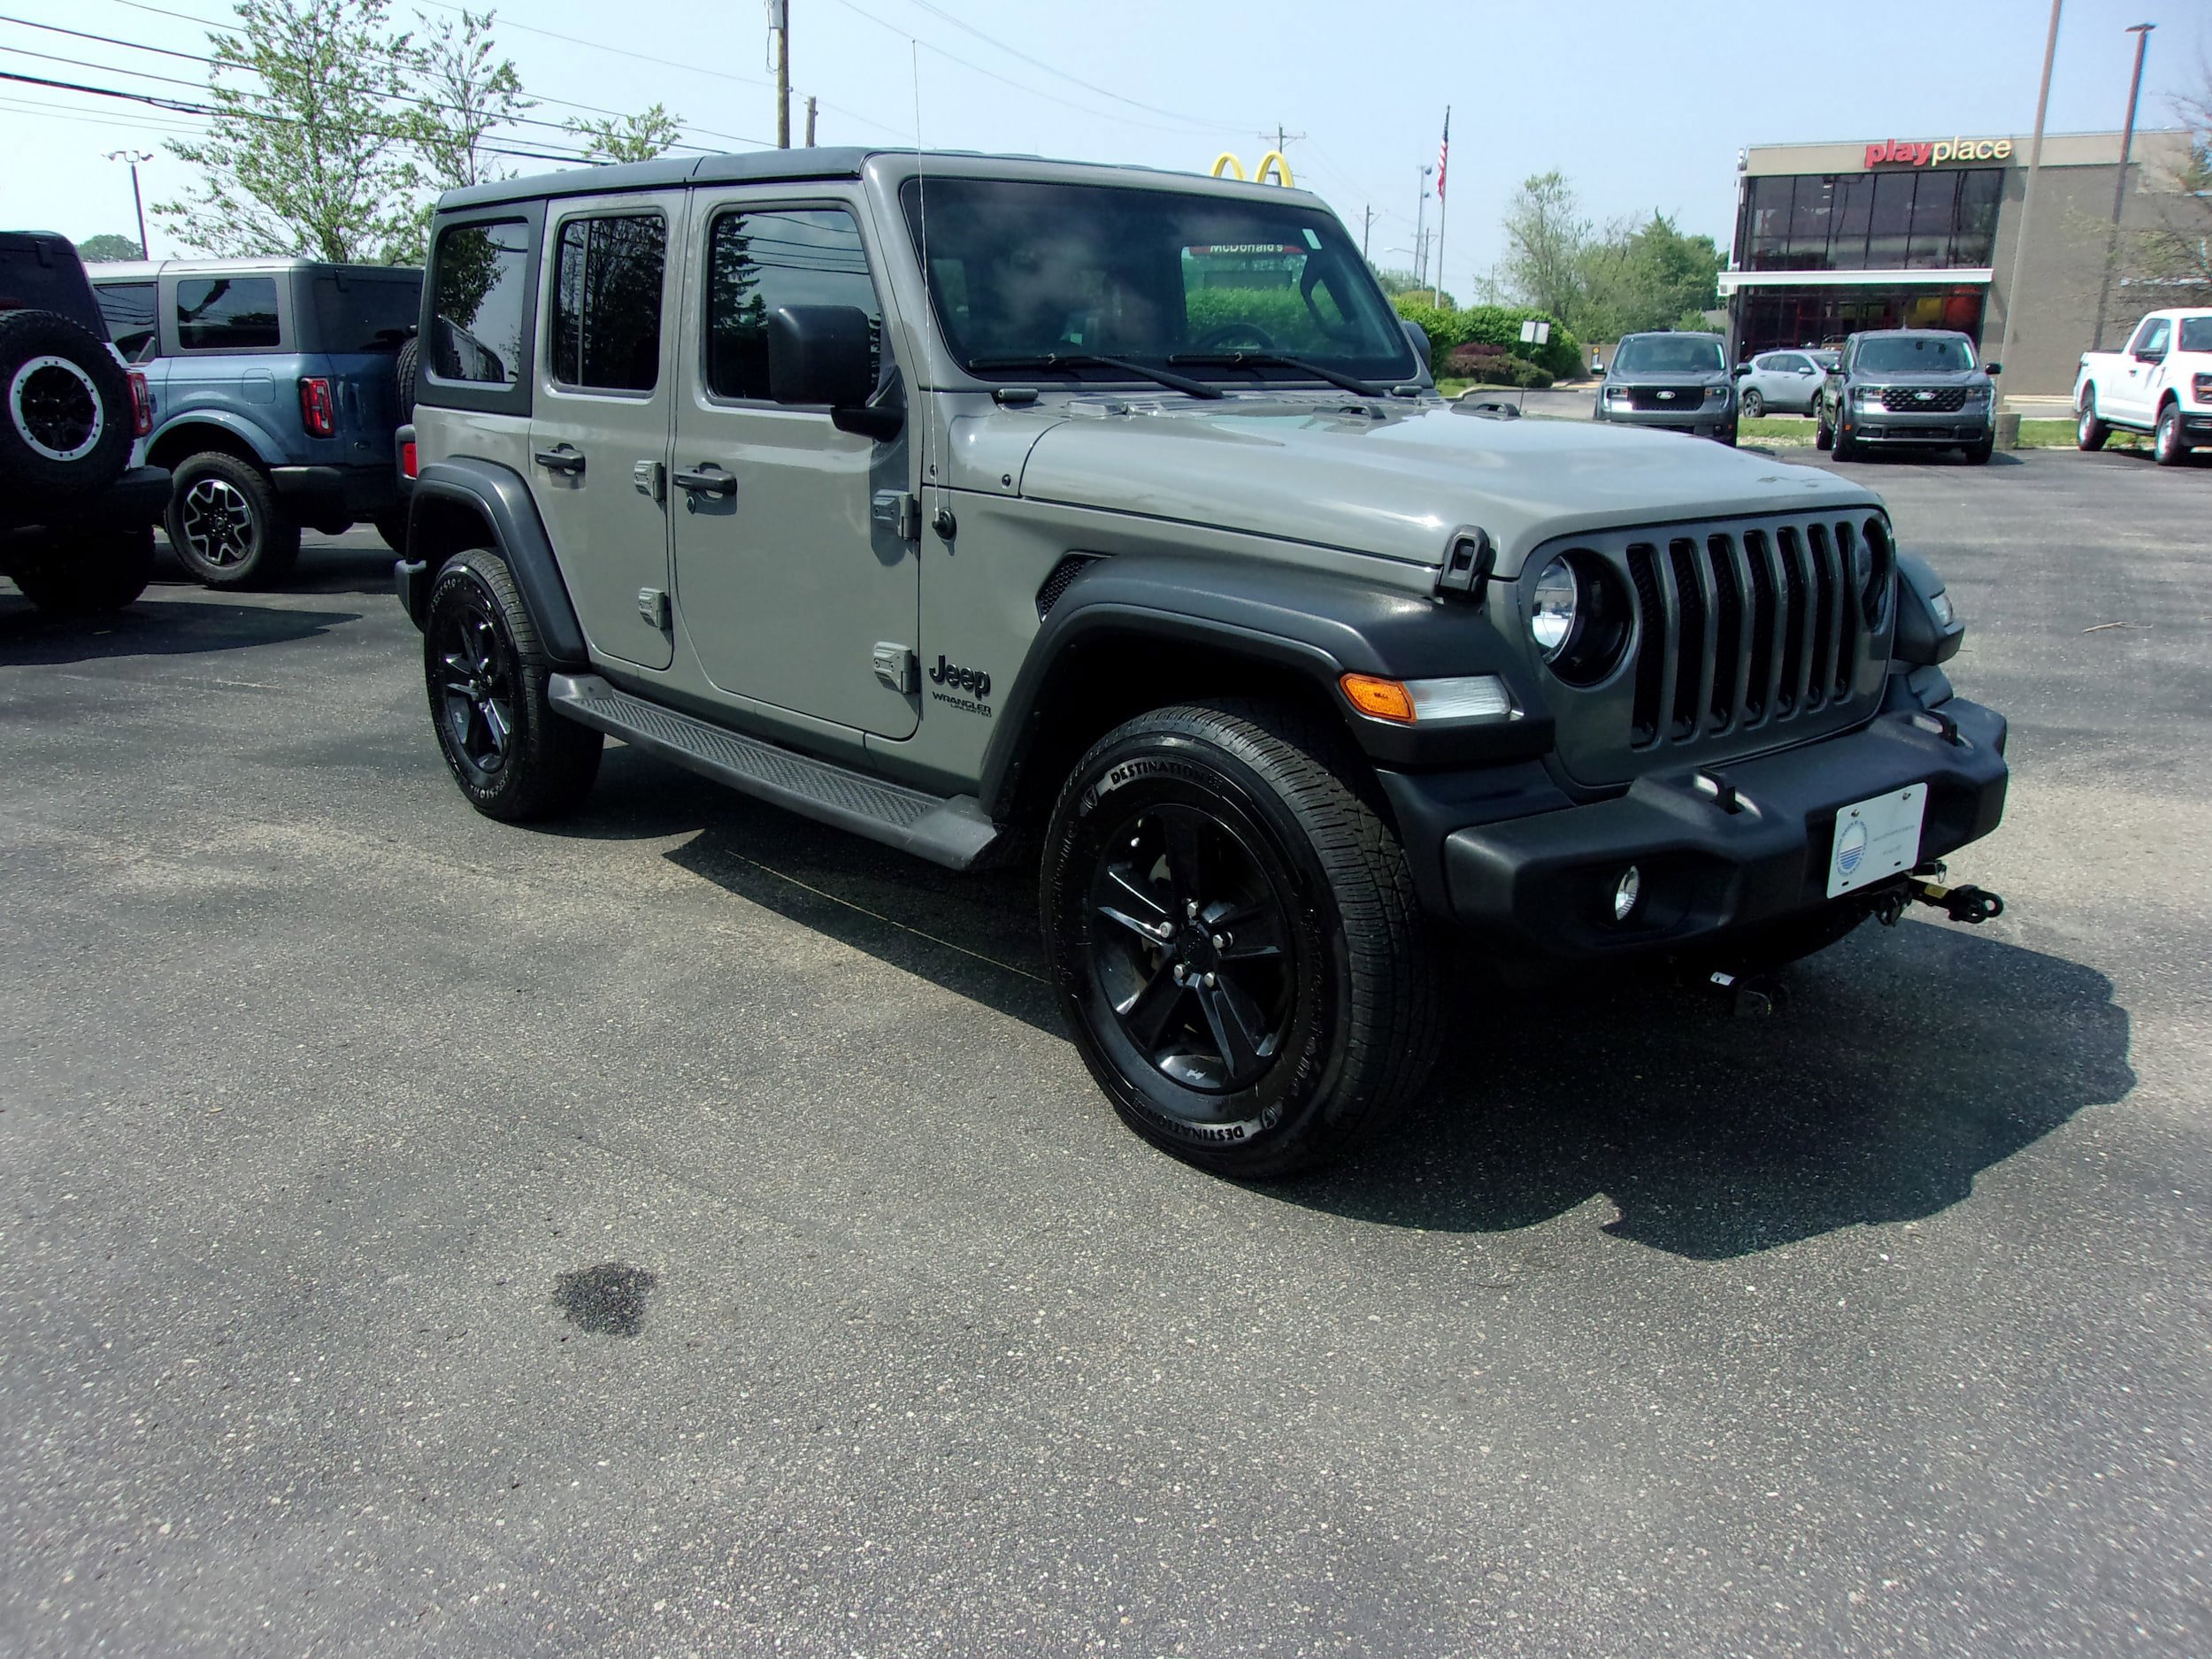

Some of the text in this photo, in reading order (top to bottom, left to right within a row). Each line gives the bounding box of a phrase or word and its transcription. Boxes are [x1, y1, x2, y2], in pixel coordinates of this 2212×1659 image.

[1864, 135, 2012, 168] playplace
[1210, 243, 1283, 253] McDonalds
[929, 654, 991, 701] Jeep
[932, 691, 991, 713] WRANGLER
[1110, 761, 1203, 784] DESTINATION
